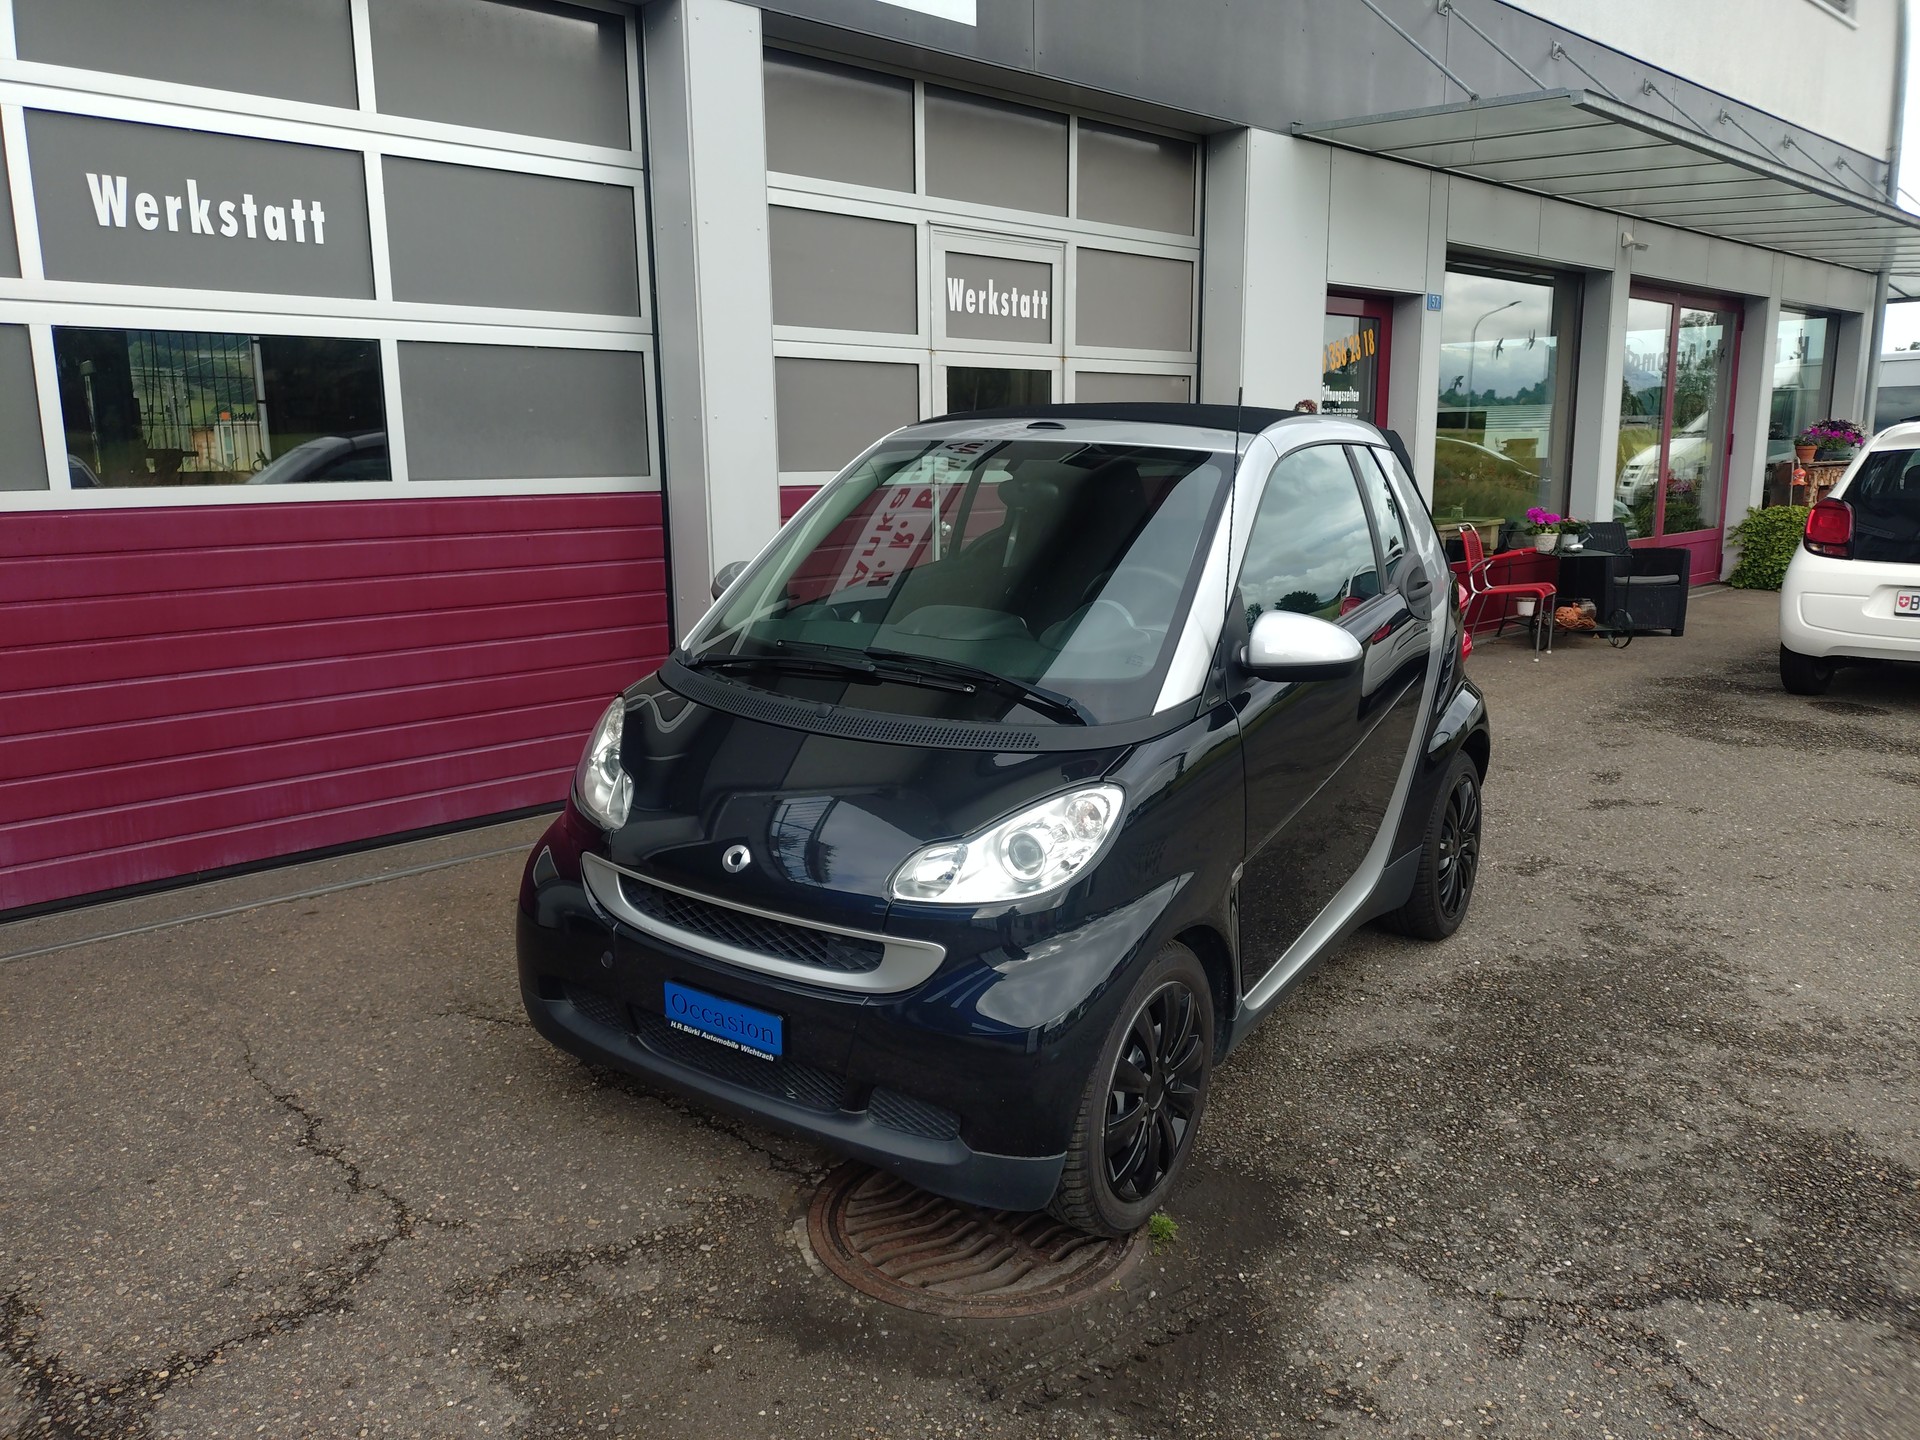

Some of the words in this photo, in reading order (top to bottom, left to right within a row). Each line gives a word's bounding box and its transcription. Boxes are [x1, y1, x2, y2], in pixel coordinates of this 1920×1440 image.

[85, 172, 325, 245] Werkstatt
[947, 277, 1048, 320] Werkstatt
[1328, 341, 1348, 371] 356
[1349, 333, 1362, 363] 23
[1363, 328, 1375, 356] 18
[672, 993, 776, 1046] Occasion
[701, 1031, 739, 1050] Automobile
